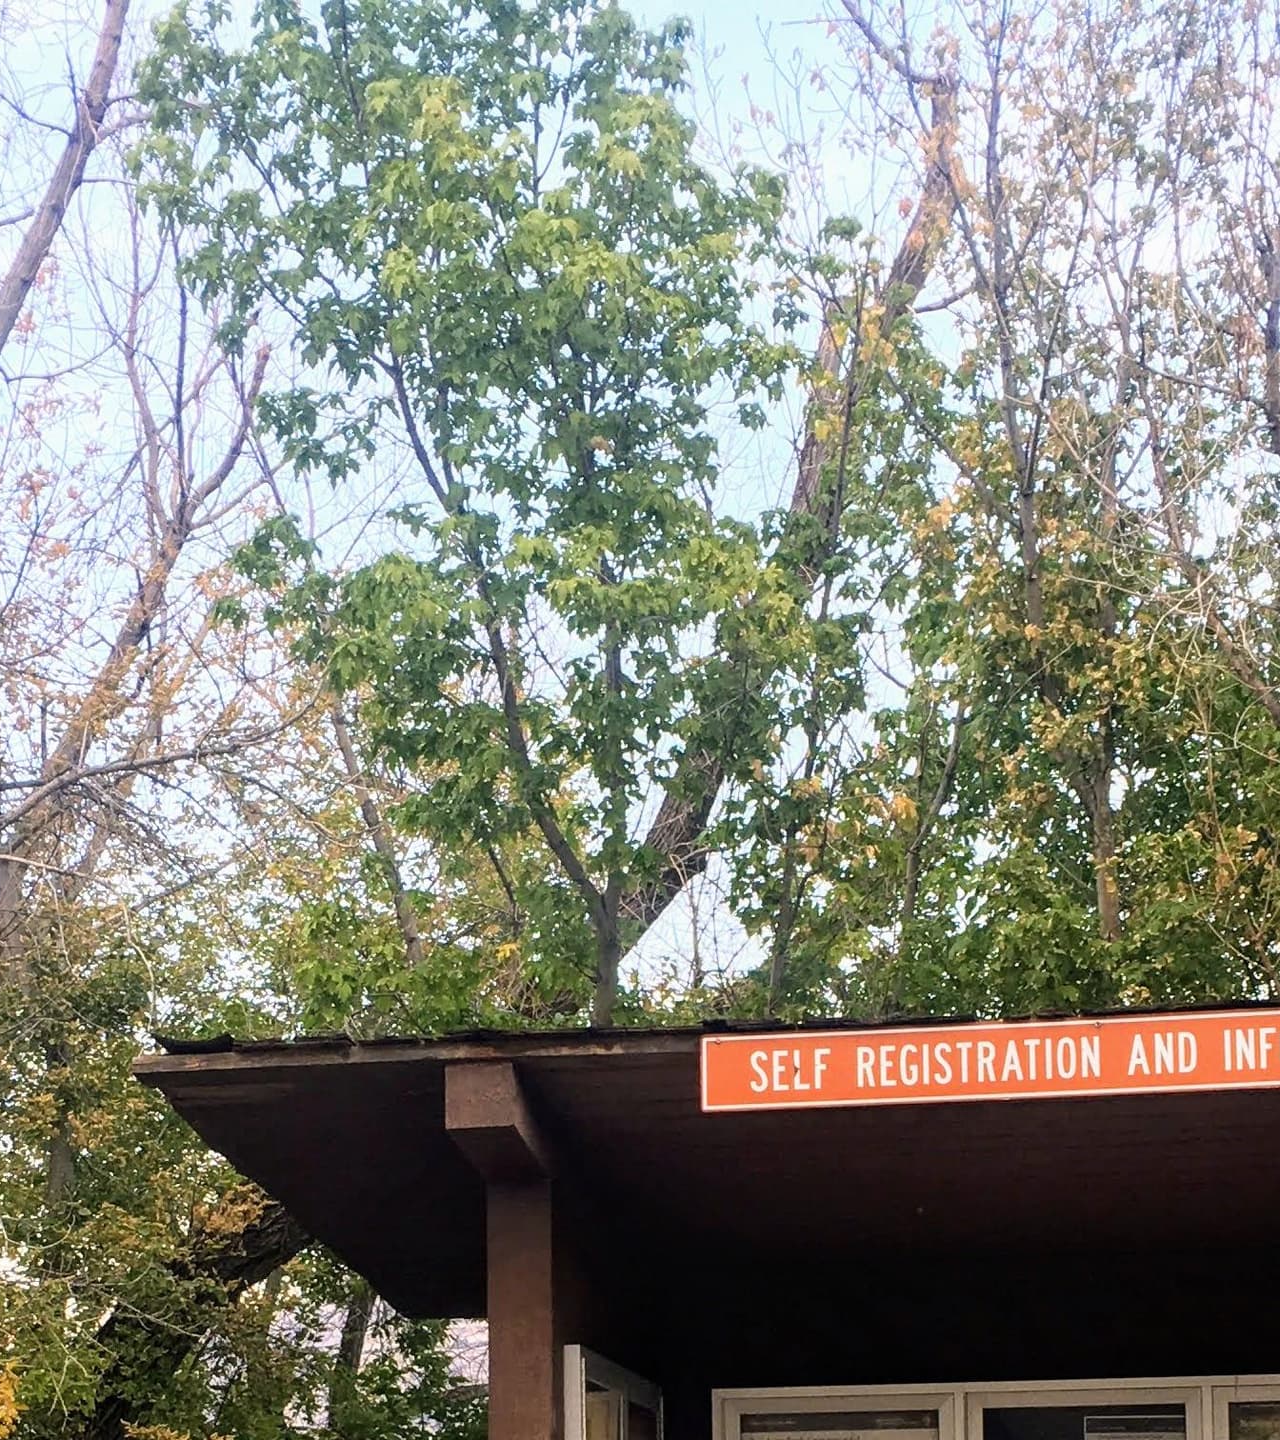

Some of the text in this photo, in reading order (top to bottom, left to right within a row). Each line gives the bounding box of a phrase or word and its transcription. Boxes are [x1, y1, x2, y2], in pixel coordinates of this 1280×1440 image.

[749, 1047, 831, 1093] SELF
[856, 1035, 1101, 1088] REGISTRATION
[1127, 1031, 1198, 1077] AND
